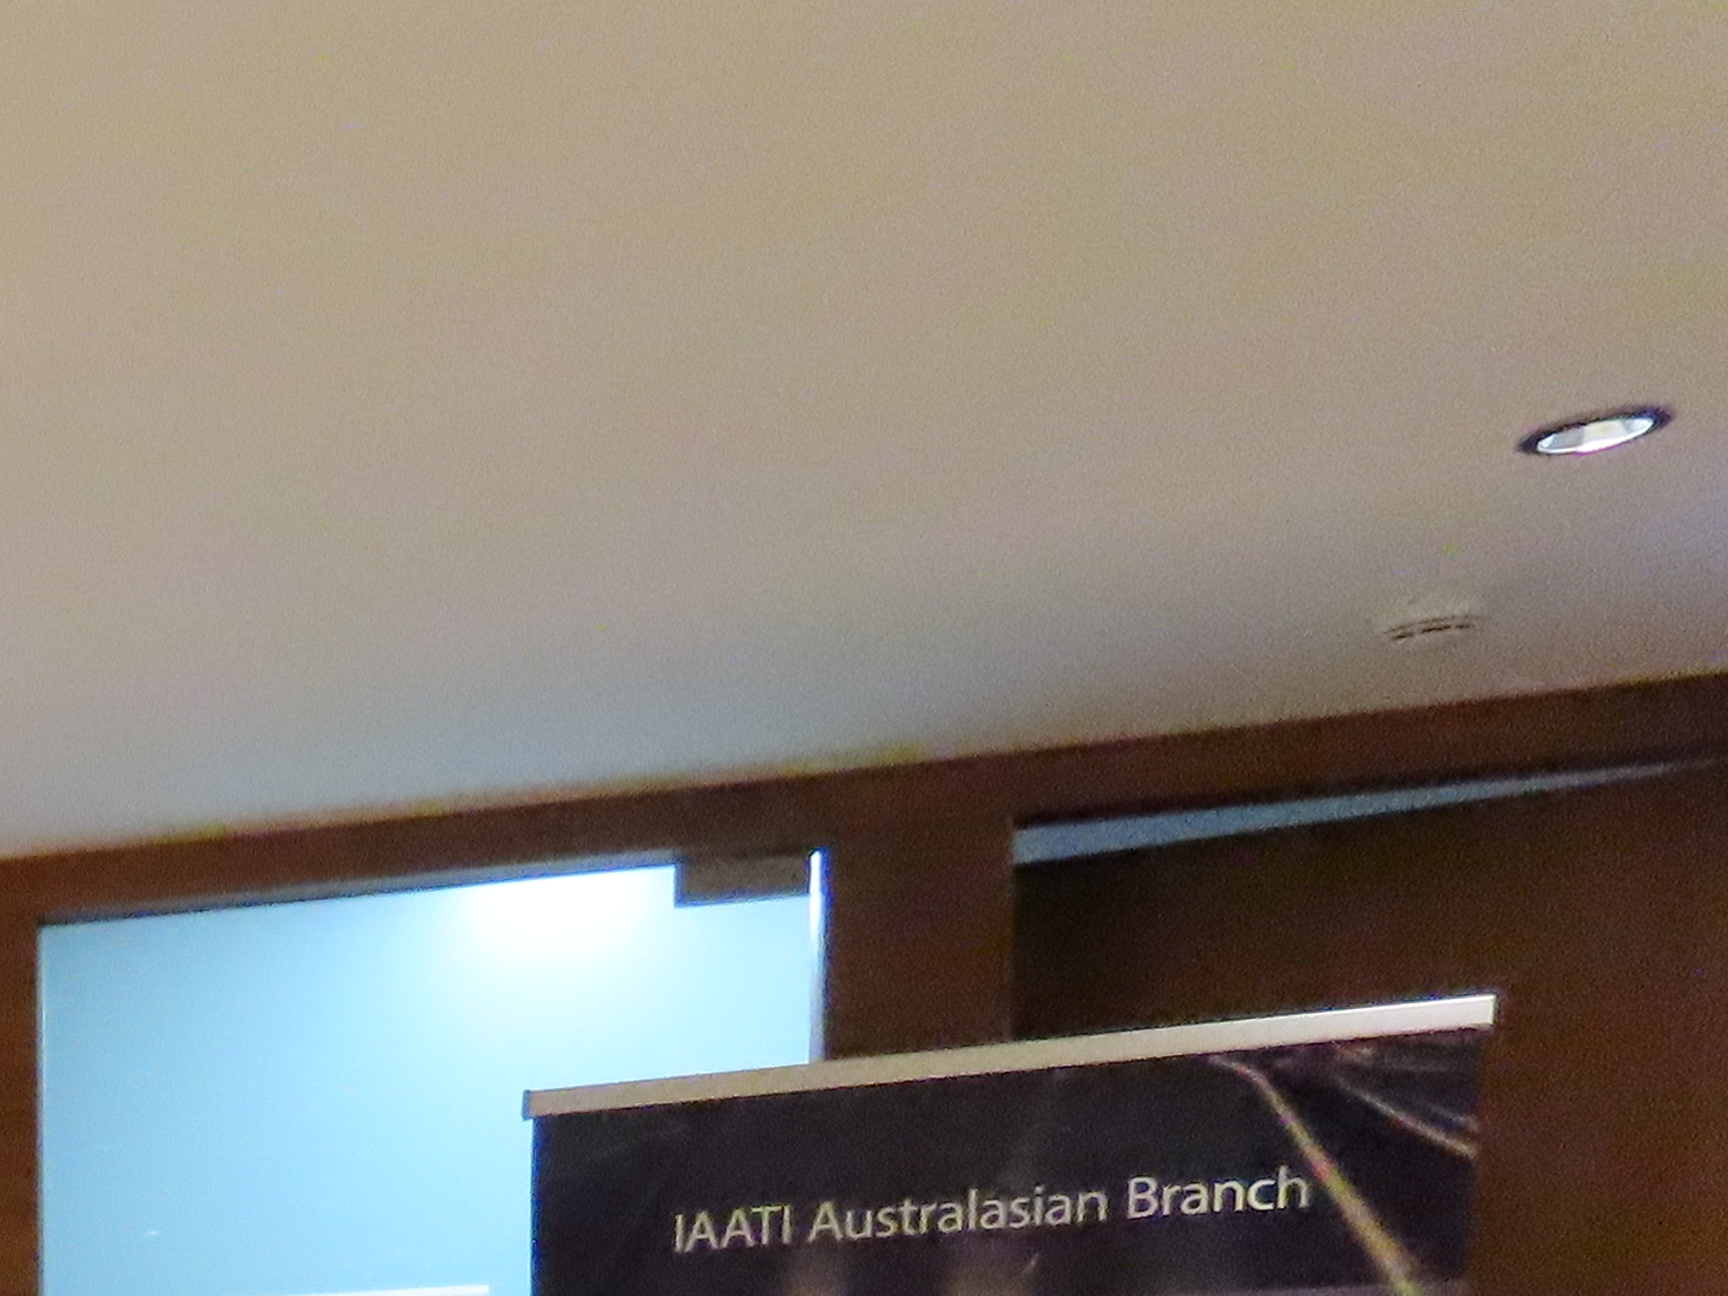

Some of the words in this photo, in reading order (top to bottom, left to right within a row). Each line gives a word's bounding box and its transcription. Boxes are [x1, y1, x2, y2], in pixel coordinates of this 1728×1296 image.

[673, 1205, 793, 1253] IAATI
[808, 1184, 1109, 1244] Australasian
[1127, 1165, 1310, 1221] Branch
